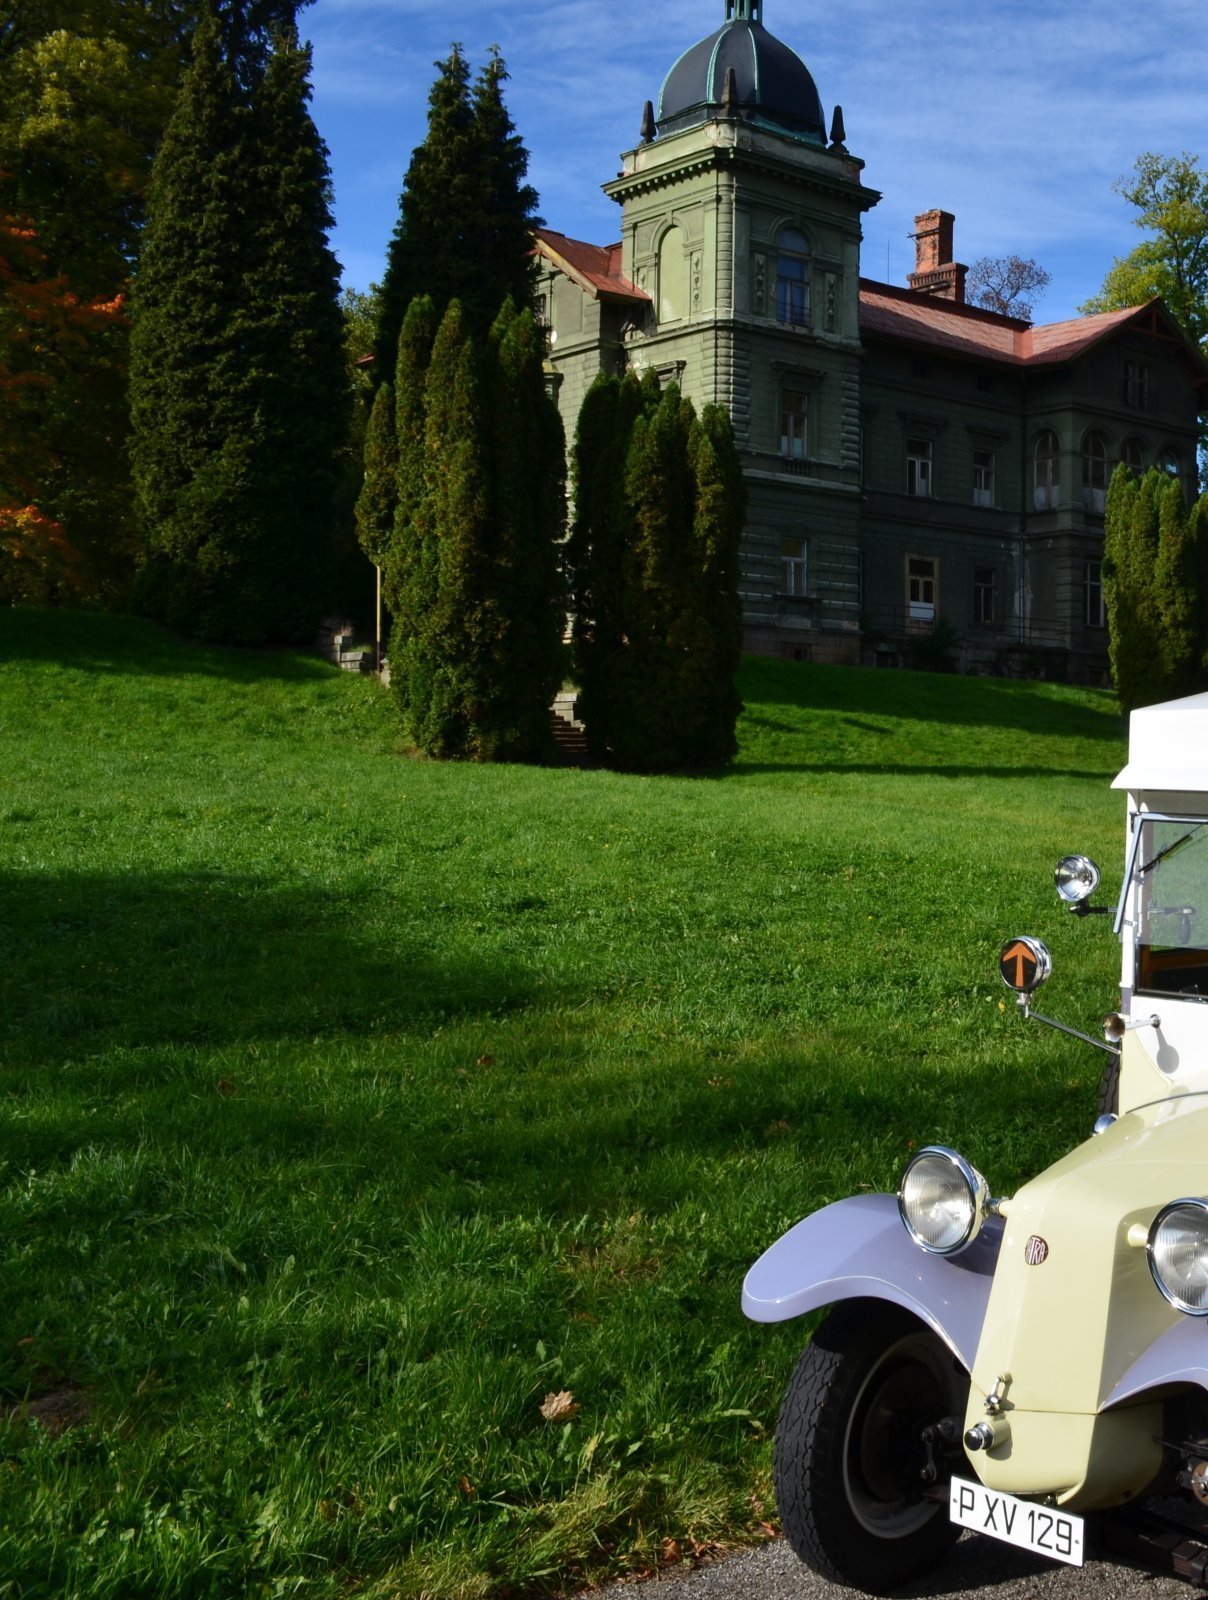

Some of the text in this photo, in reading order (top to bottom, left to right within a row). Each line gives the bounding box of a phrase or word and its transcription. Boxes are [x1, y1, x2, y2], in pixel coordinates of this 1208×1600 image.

[1026, 1236, 1046, 1264] TRA
[959, 1486, 1072, 1555] P XV 129
